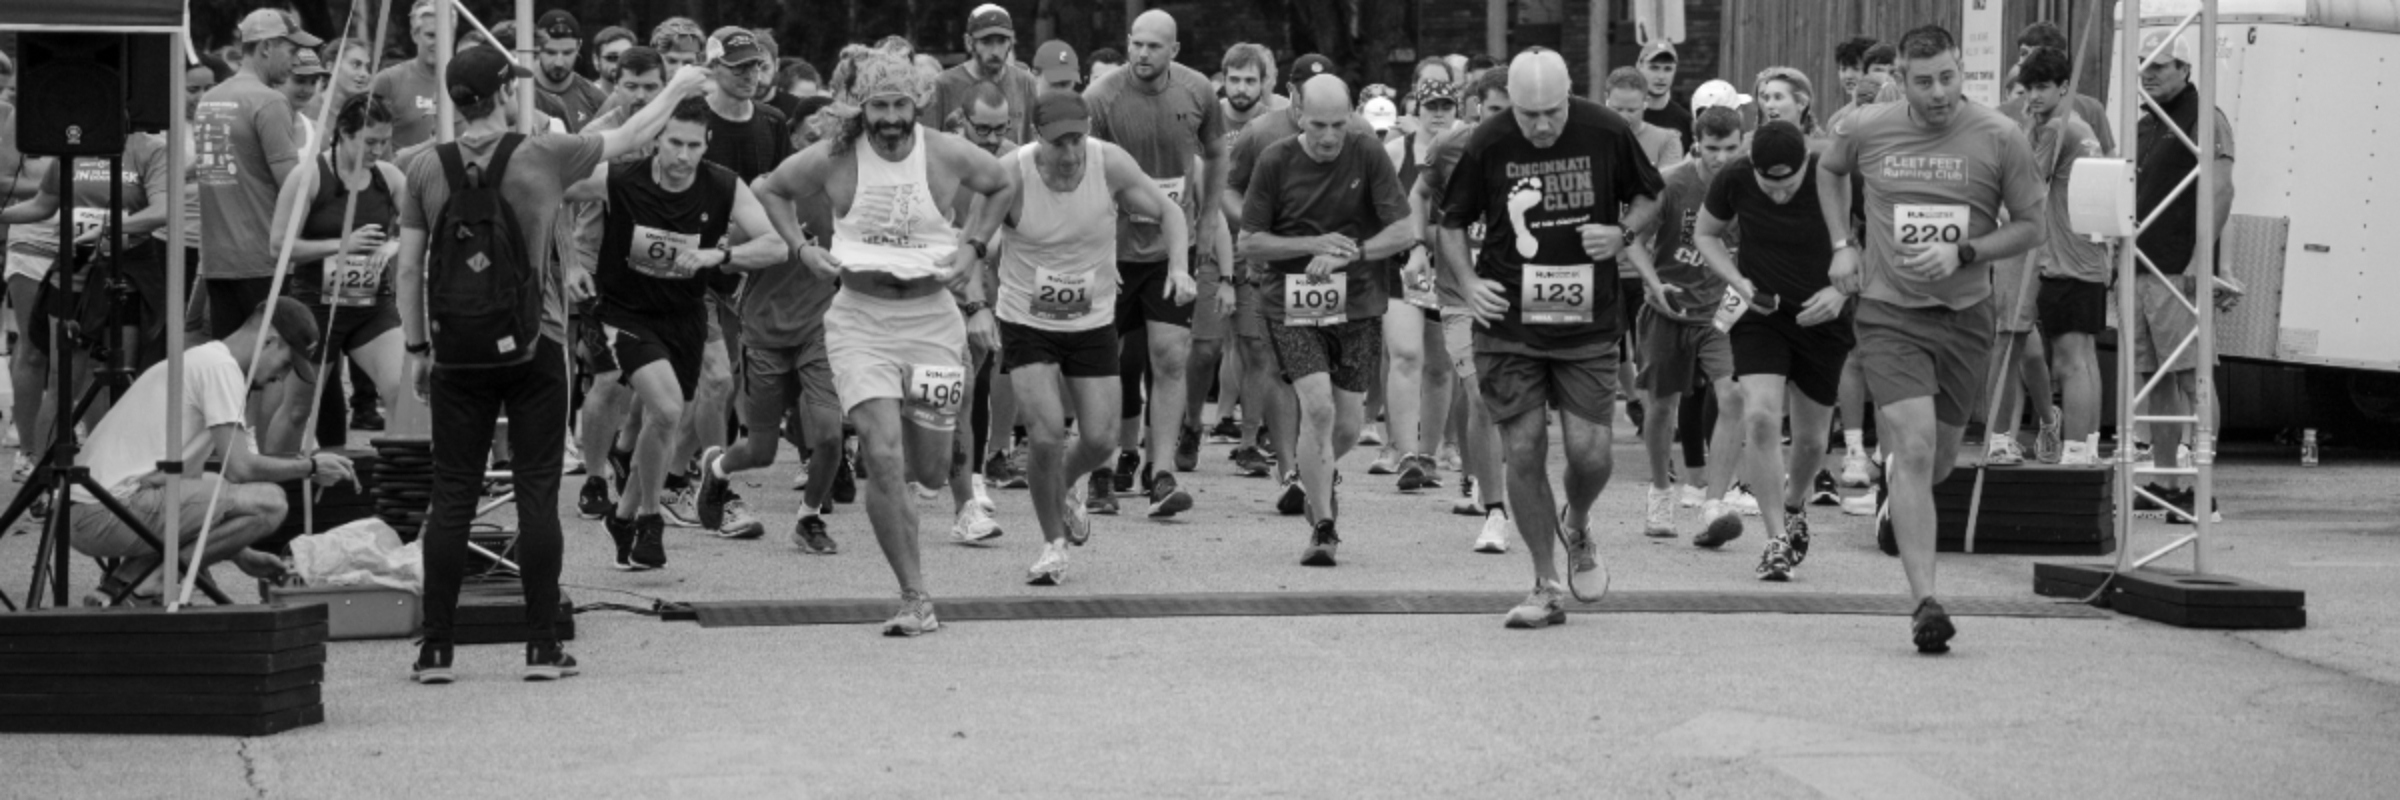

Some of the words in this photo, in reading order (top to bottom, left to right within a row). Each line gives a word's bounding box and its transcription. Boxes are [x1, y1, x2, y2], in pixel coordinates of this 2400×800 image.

[1505, 155, 1591, 178] CINCINNATI
[1884, 155, 1926, 168] FLEET
[1929, 157, 1963, 170] FEET
[1544, 171, 1592, 193] RUN
[1883, 167, 1933, 180] Running
[1935, 169, 1963, 181] Club
[1543, 191, 1595, 212] CLUB
[75, 221, 99, 237] 1
[1901, 223, 1961, 245] 220
[647, 241, 677, 261] 61
[1040, 285, 1085, 305] 201
[1292, 289, 1340, 311] 109
[1532, 283, 1584, 307] 123
[919, 381, 962, 409] 196
